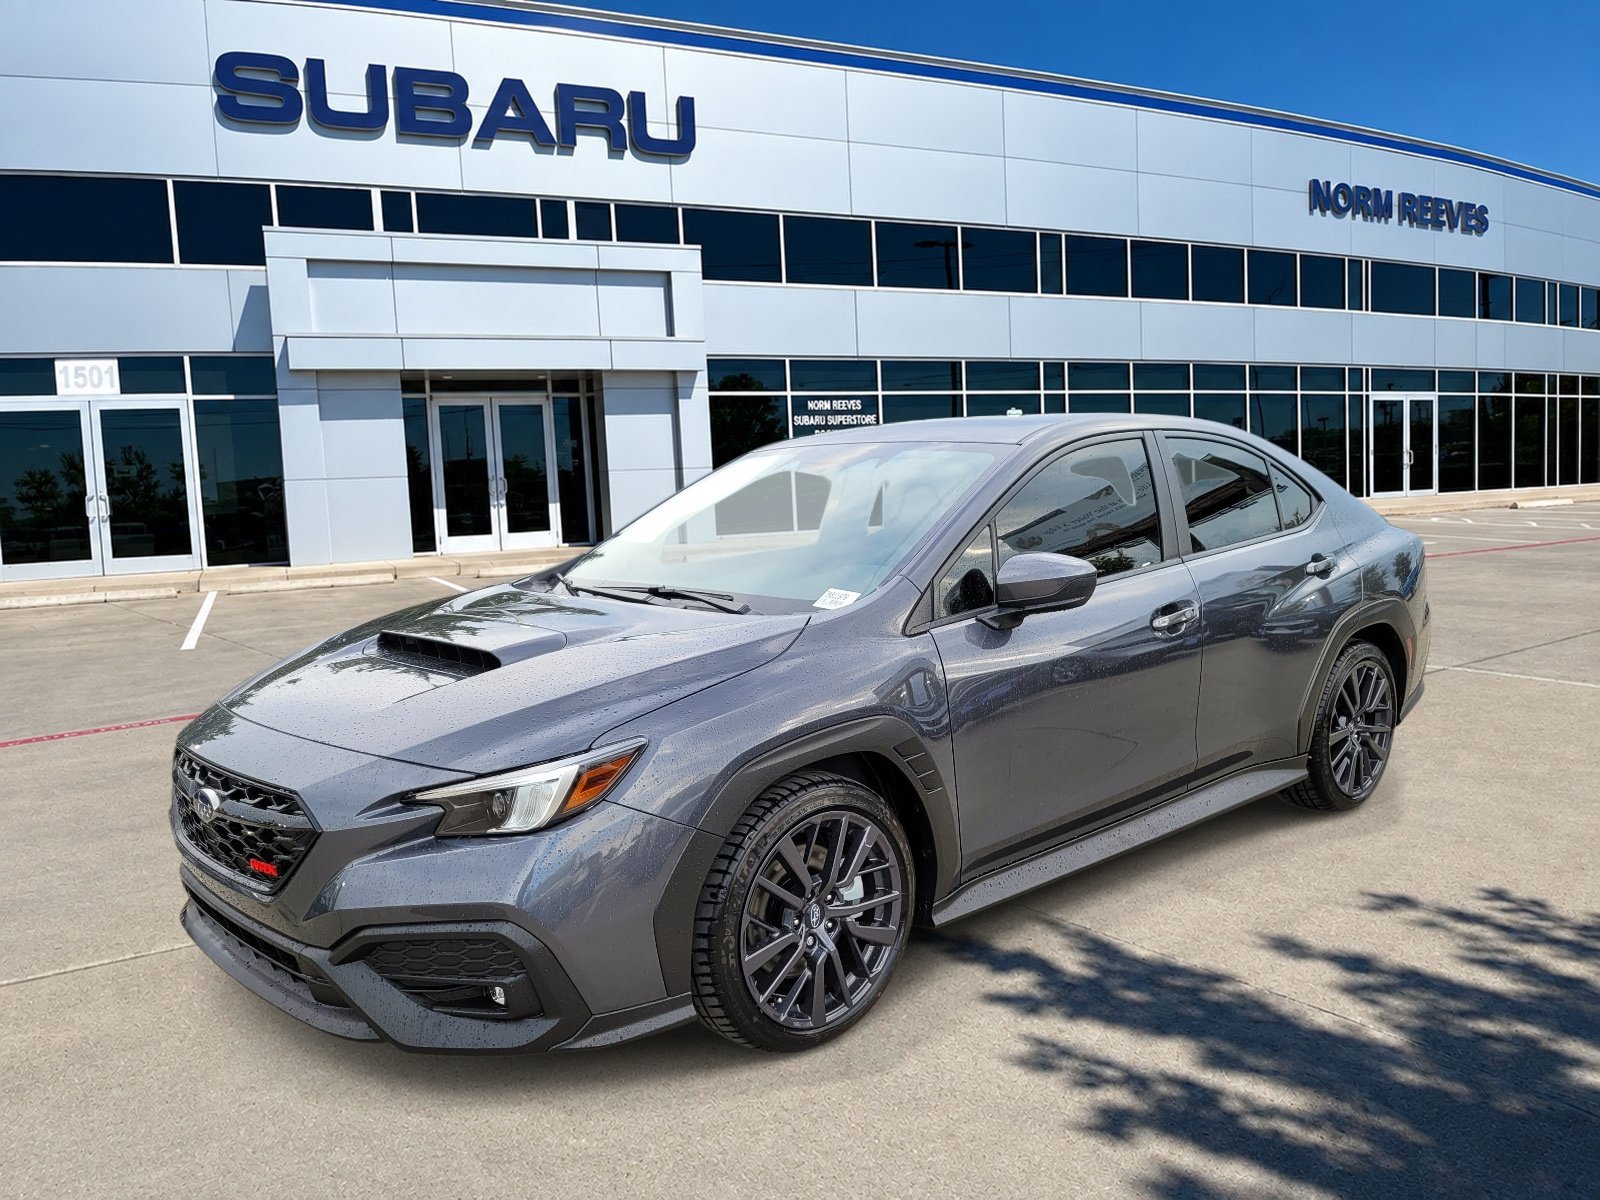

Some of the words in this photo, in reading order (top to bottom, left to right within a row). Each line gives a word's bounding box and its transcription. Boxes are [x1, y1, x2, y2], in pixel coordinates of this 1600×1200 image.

[214, 51, 696, 158] SUBARU
[1309, 179, 1393, 220] NORM
[1398, 192, 1489, 236] REEVES
[59, 365, 115, 389] 1501
[807, 400, 831, 411] NORM
[832, 400, 862, 410] REEVES
[793, 415, 826, 426] SUBARU
[827, 414, 877, 425] SUPERSTORE
